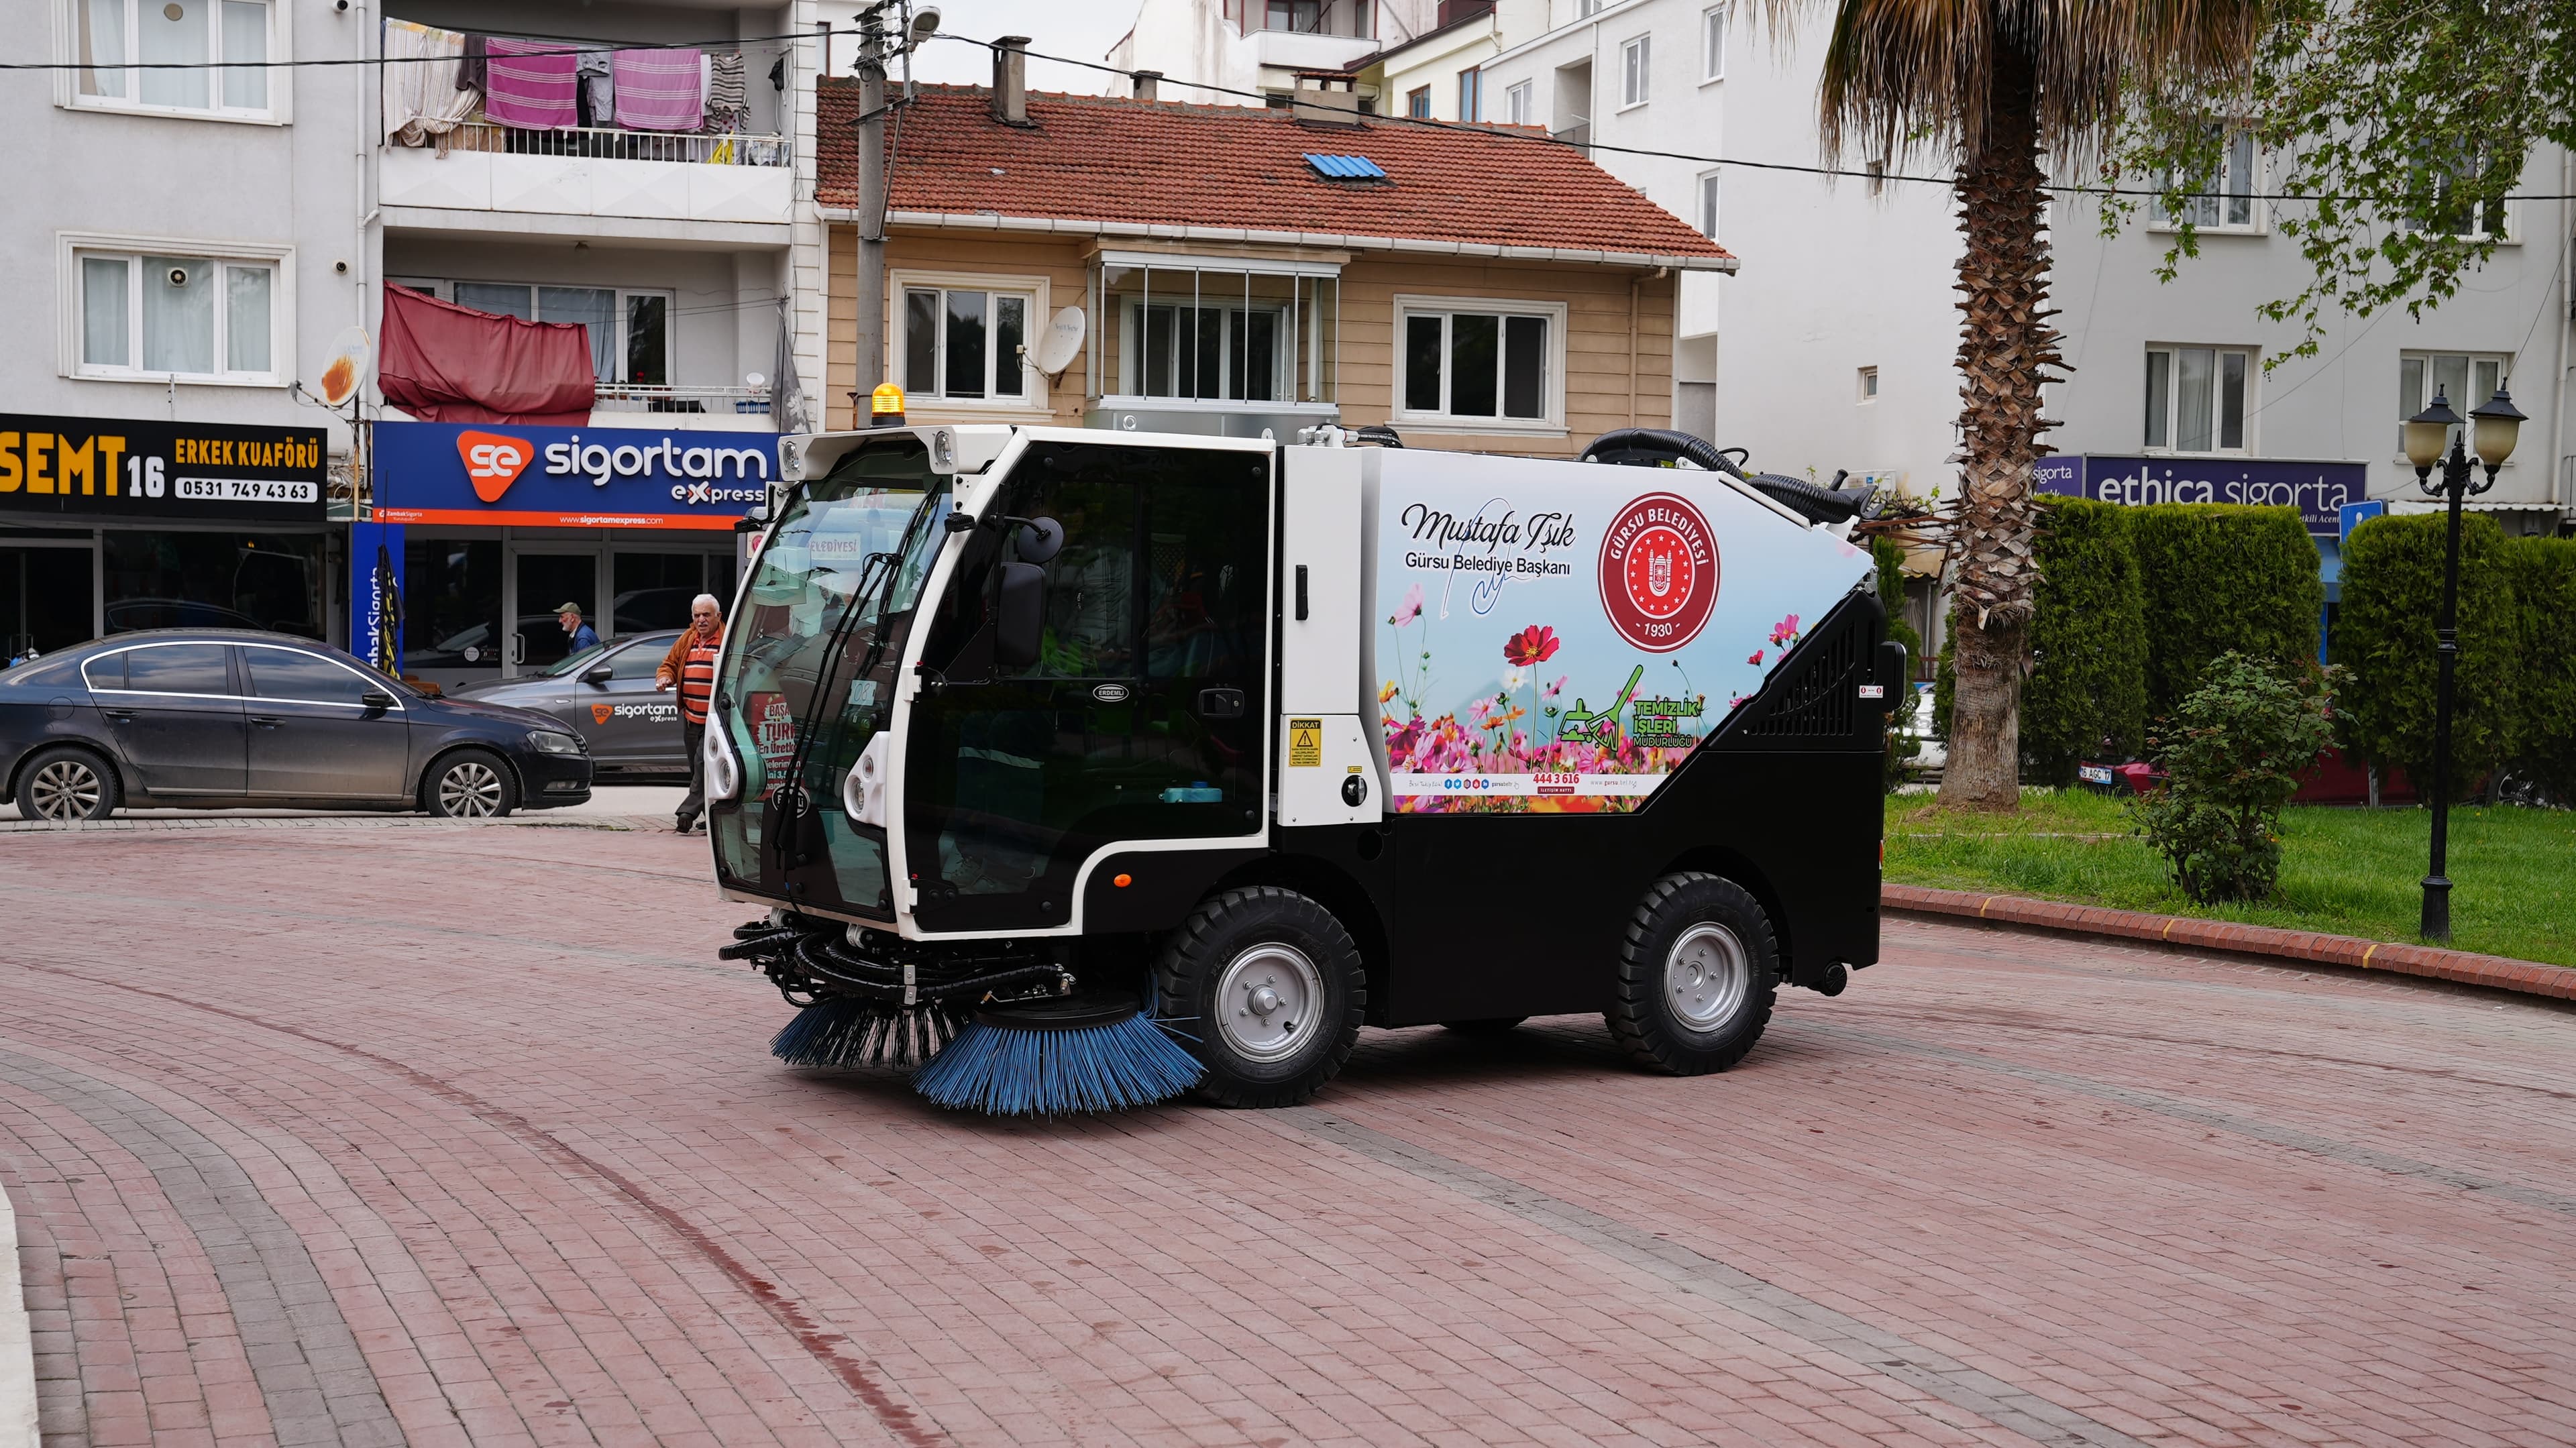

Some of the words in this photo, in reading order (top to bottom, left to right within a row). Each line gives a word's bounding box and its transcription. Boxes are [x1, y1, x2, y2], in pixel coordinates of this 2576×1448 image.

[175, 439, 233, 465] ERKEK
[238, 437, 318, 468] KUAFÖRÜ
[545, 435, 767, 486] sigortam
[0, 431, 125, 496] SEMT
[127, 455, 165, 498] 16
[2033, 465, 2073, 484] sigorta
[184, 481, 222, 496] 0531
[231, 483, 260, 498] 749
[266, 484, 286, 498] 43
[290, 485, 308, 499] 63
[2099, 466, 2214, 506] ethica
[2225, 474, 2347, 512] sigorta
[559, 515, 663, 525] www.sigortamexpress.com
[1401, 504, 1521, 554] Mustafa
[1611, 512, 1645, 560] GÜRSU
[1648, 508, 1709, 565] BELEDİYESİ
[1406, 553, 1449, 569] Gürsu
[1454, 555, 1513, 575] Belediye
[1517, 558, 1570, 577] Başkanı
[1644, 622, 1672, 637] 1930
[614, 703, 678, 718] sigortam
[1634, 698, 1699, 716] TEMİZLİK
[1633, 716, 1676, 736] İŞLERİ
[1633, 734, 1693, 747] MÜDÜRLÜĞÜ
[1534, 773, 1552, 783] 444
[1554, 773, 1560, 783] 3
[1562, 773, 1580, 784] 616
[2082, 768, 2087, 777] 16
[2089, 769, 2101, 779] AGC
[2105, 771, 2110, 780] 17
